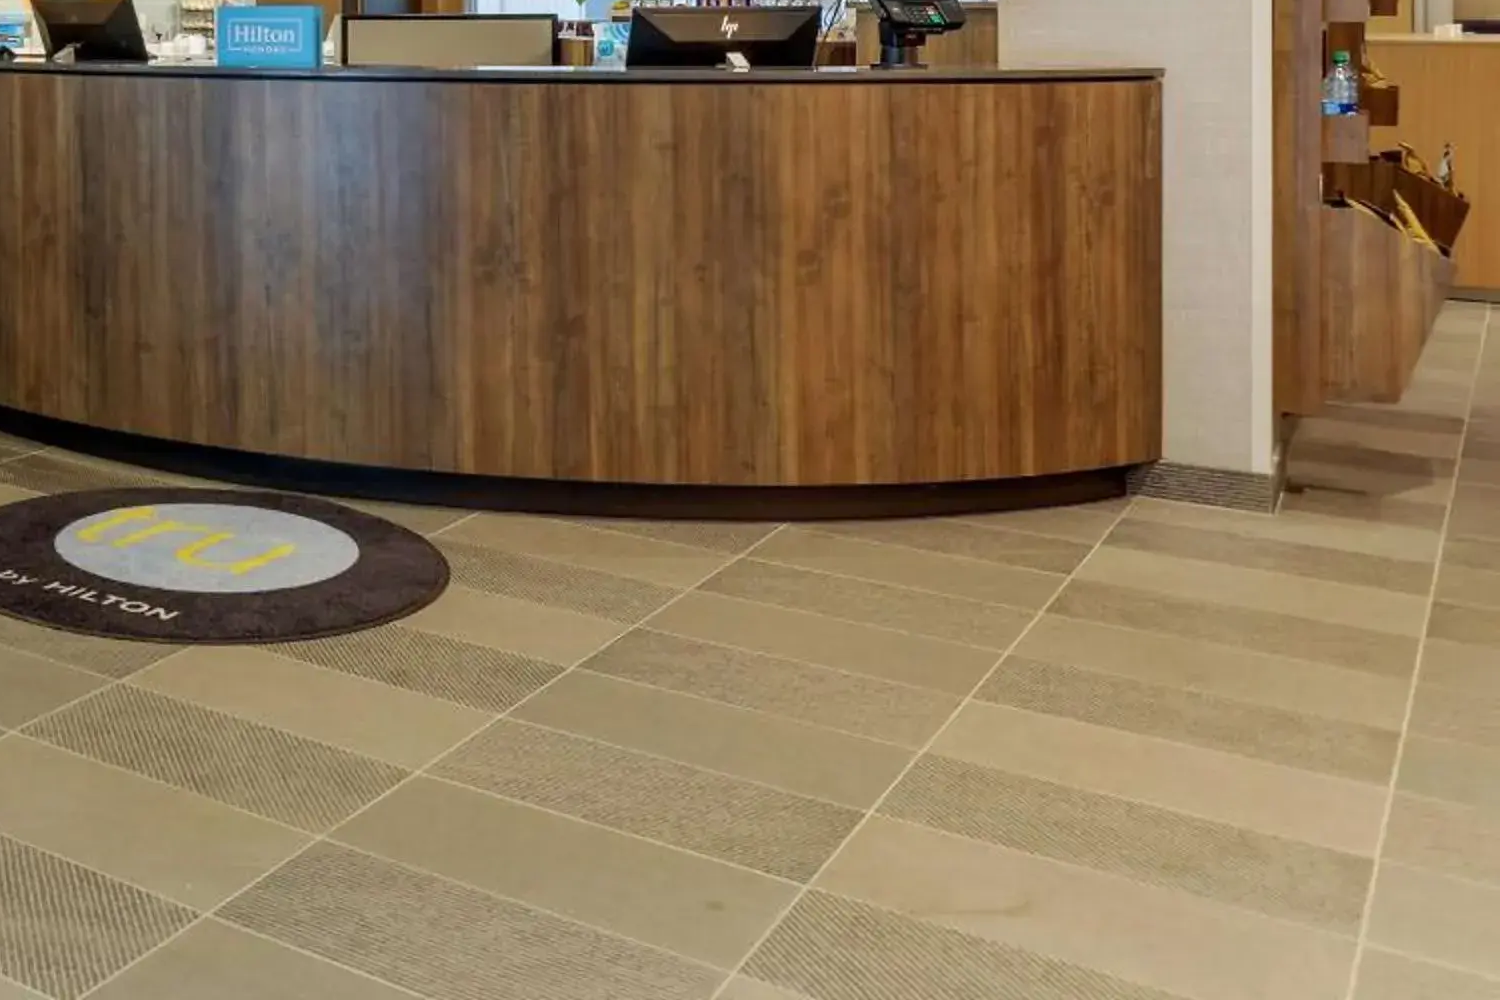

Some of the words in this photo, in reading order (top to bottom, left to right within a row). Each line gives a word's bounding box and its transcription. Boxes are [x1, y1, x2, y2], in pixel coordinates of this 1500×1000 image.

[234, 23, 296, 44] Hilton
[721, 15, 739, 39] hp
[74, 505, 296, 576] tru
[43, 581, 180, 621] HILTON
